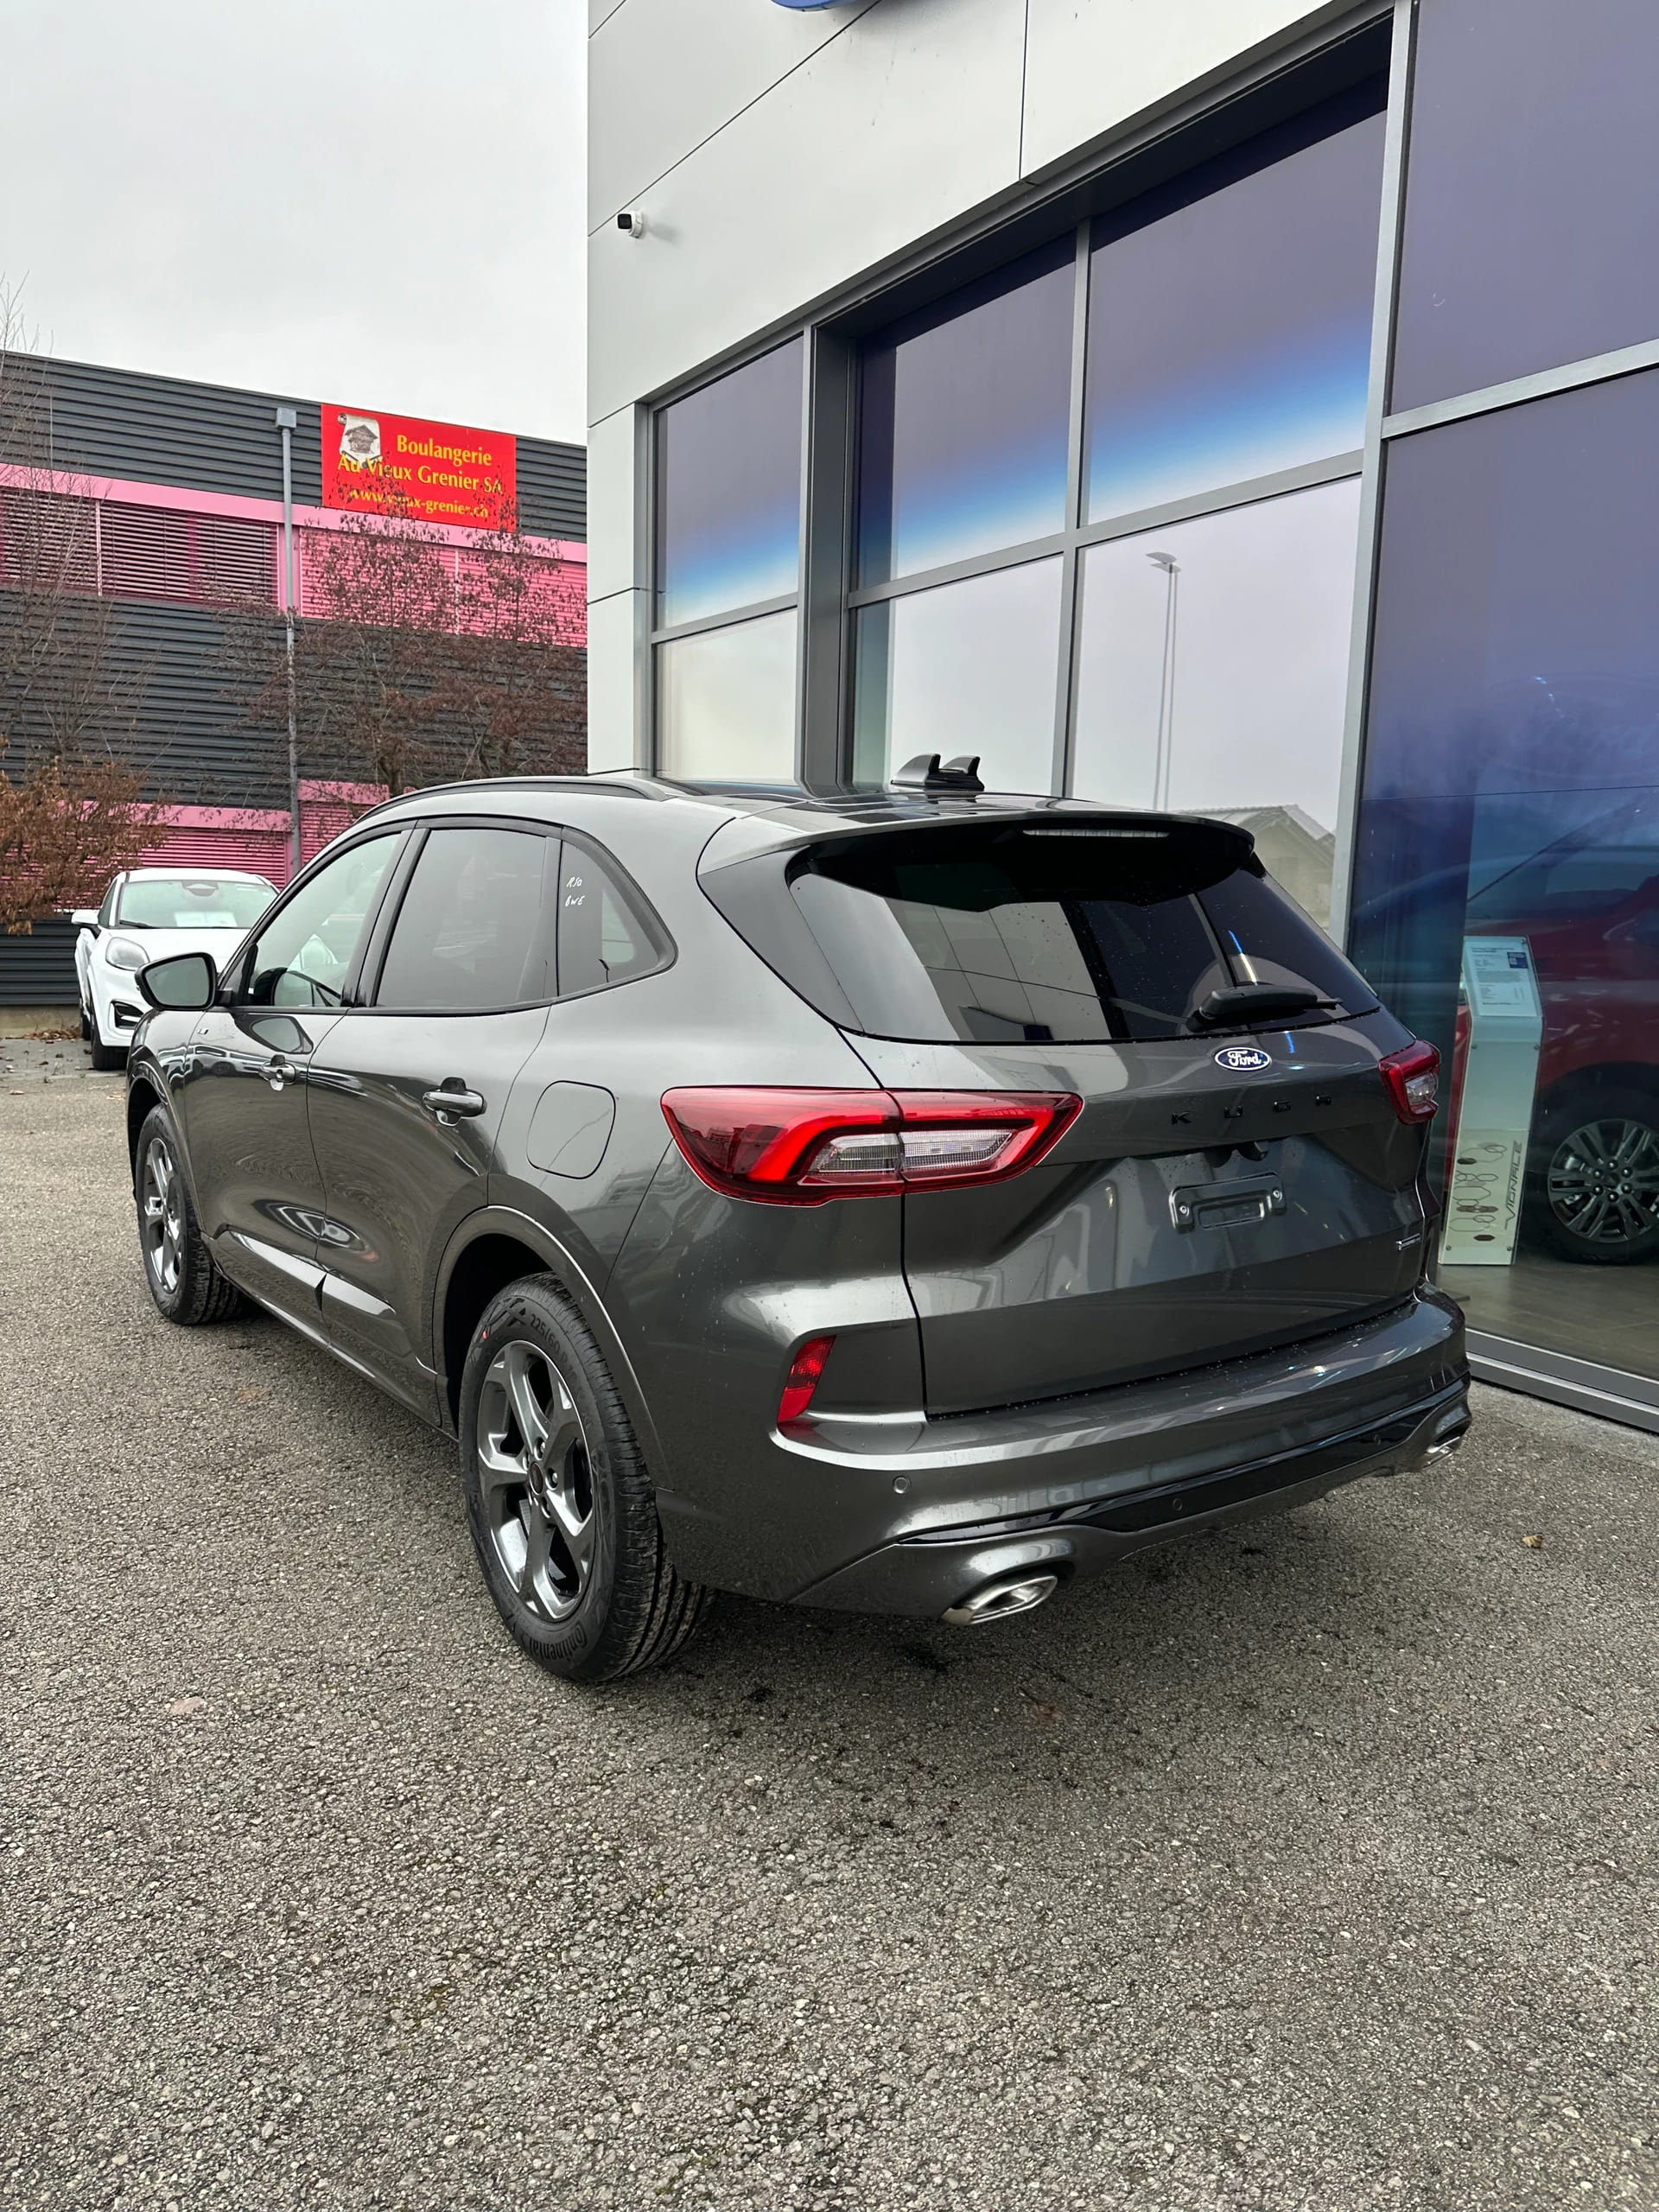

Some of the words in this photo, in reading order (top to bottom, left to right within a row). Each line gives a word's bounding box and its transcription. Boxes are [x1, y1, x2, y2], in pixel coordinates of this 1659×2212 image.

[397, 435, 493, 467] Boulangerie
[337, 454, 361, 474] Au
[366, 457, 413, 481] Vieux
[417, 465, 480, 491] Grenier
[483, 476, 503, 494] SA
[1226, 1049, 1263, 1067] Ford
[530, 1313, 561, 1354] 225/60
[528, 1619, 588, 1662] Continental
